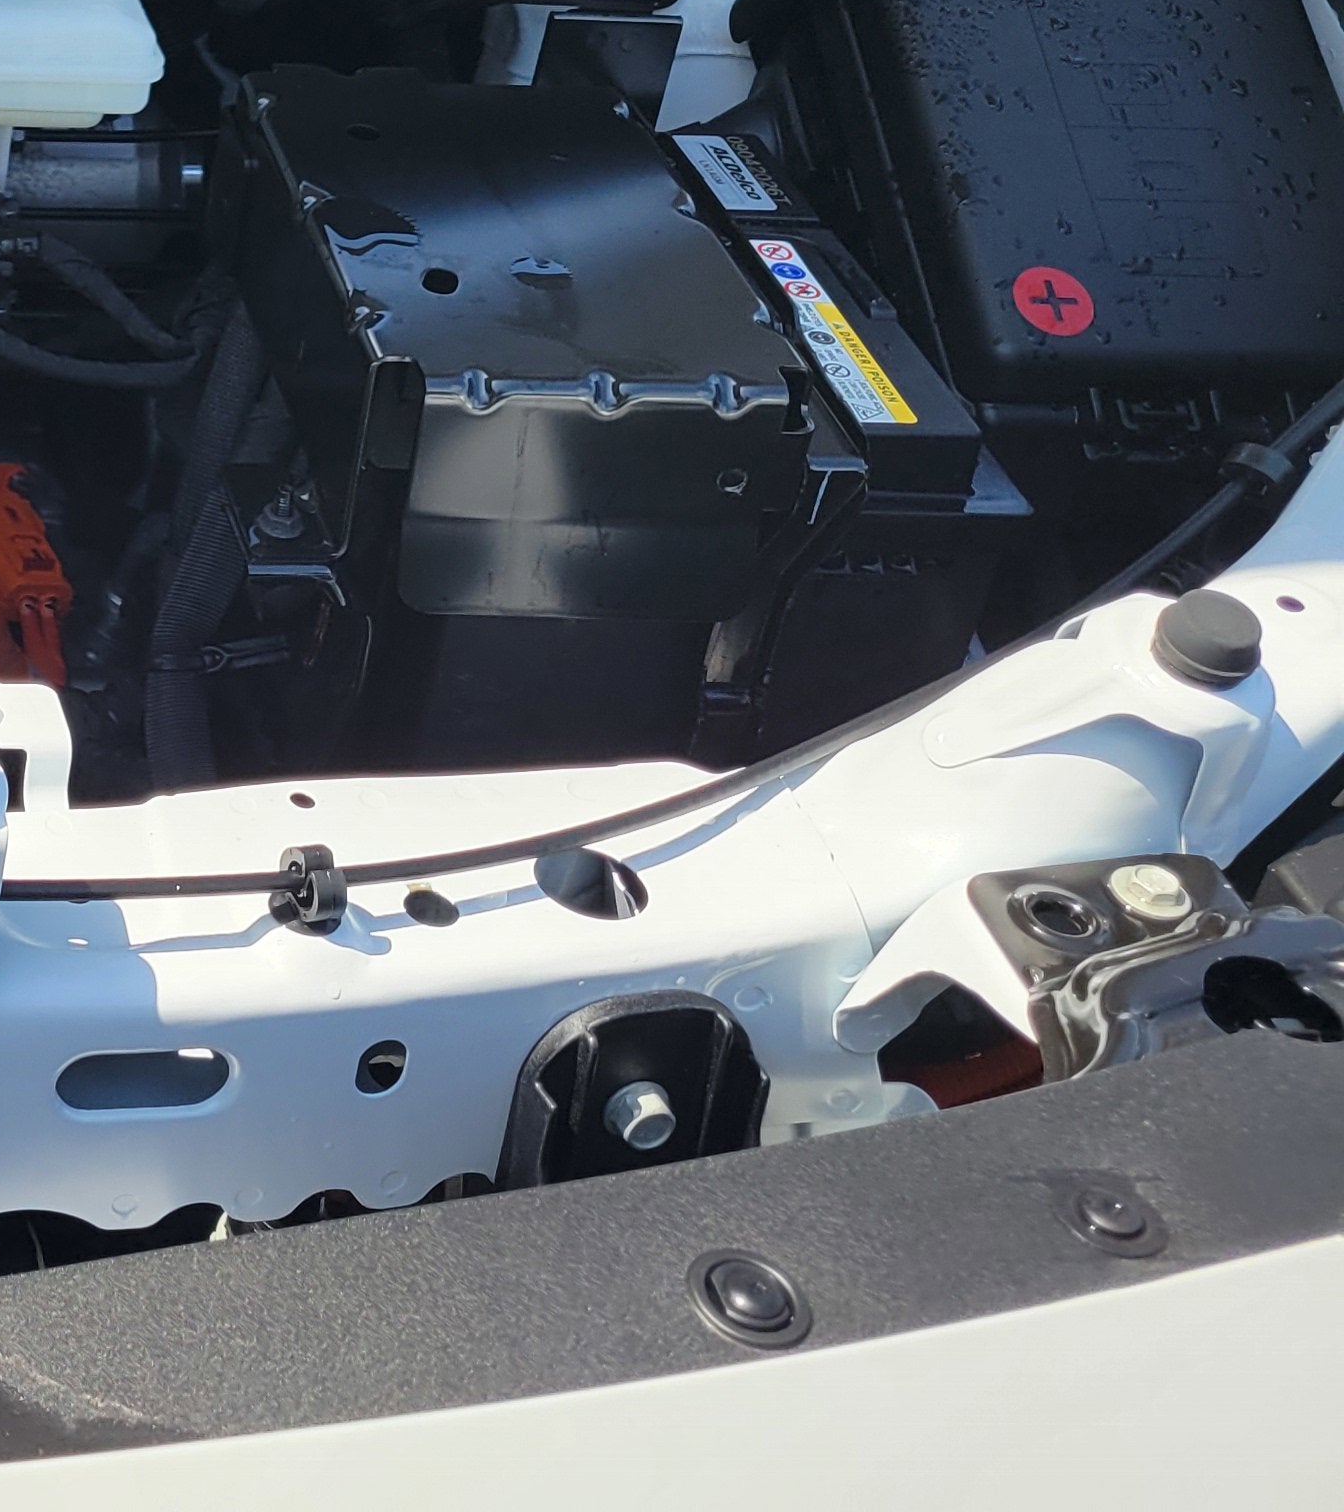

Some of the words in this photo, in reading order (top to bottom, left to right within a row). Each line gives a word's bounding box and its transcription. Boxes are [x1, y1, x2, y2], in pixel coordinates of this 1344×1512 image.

[708, 145, 762, 201] ACDelco
[838, 330, 872, 368] DANGER
[868, 371, 900, 404] POISON
